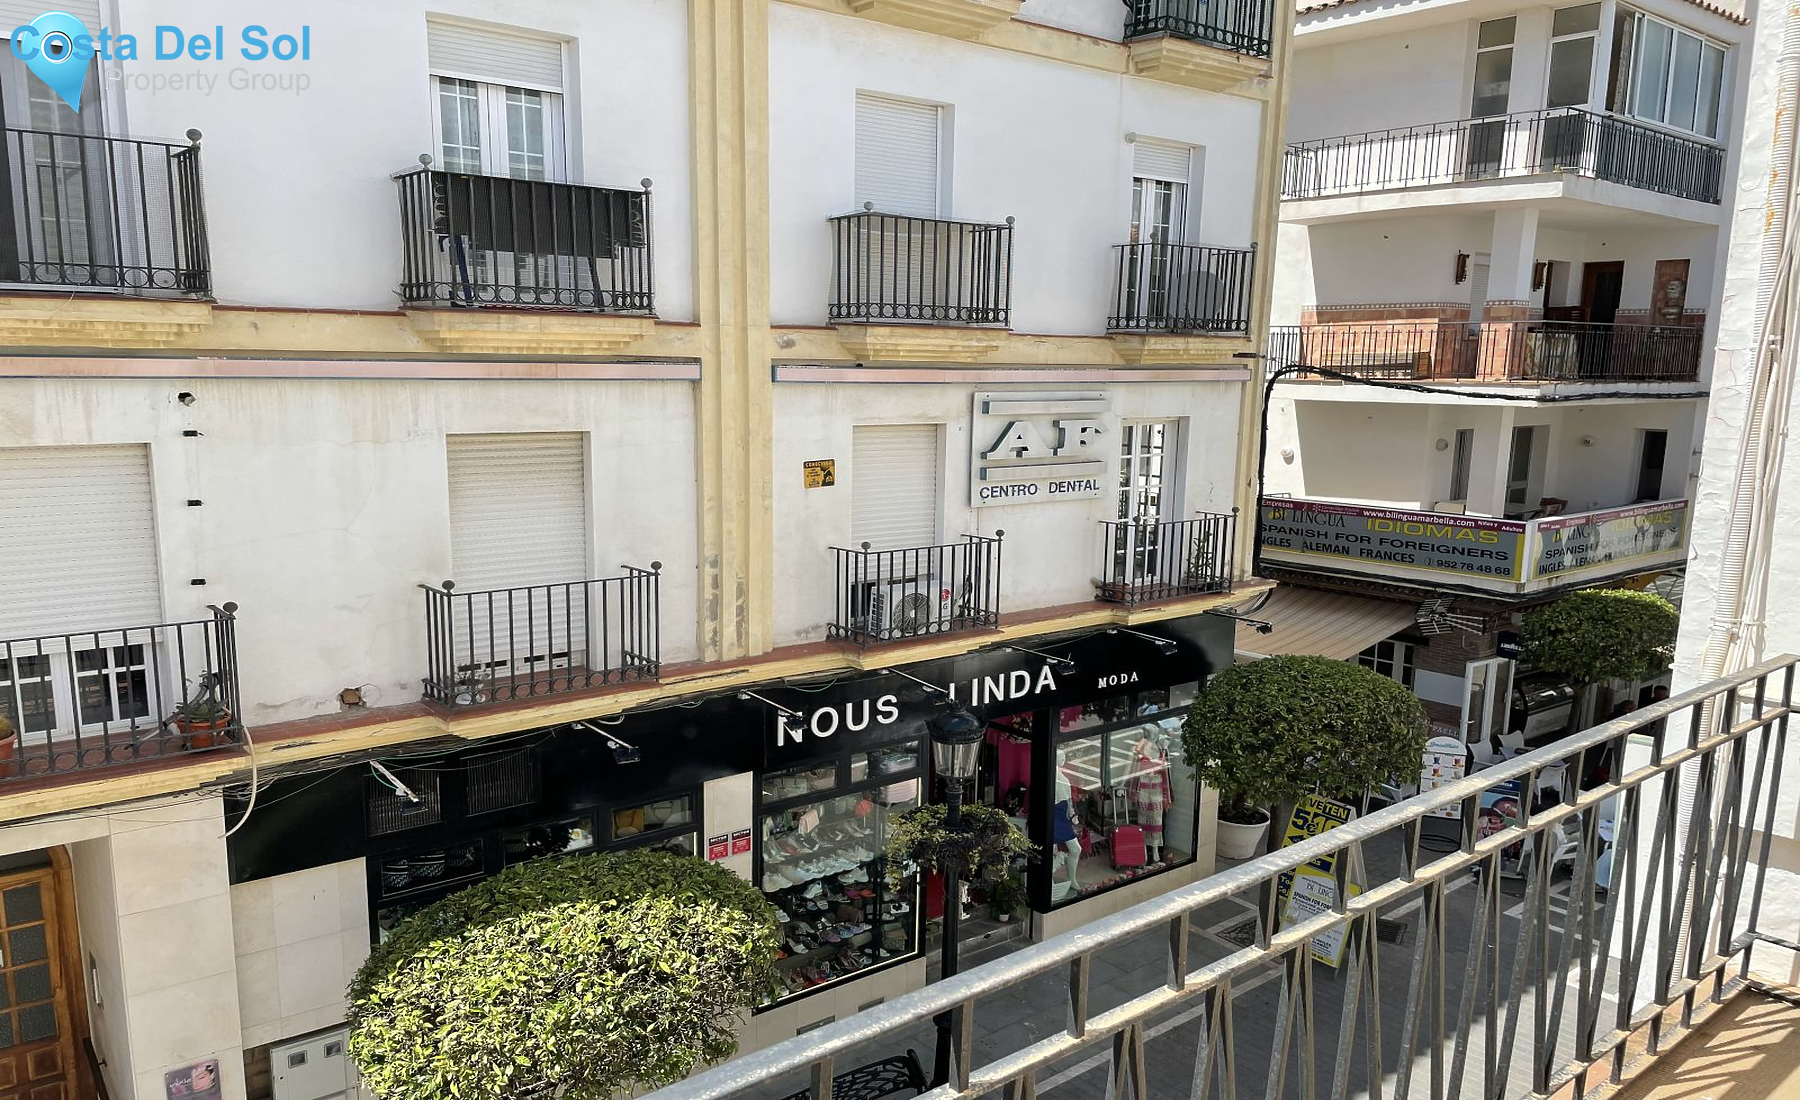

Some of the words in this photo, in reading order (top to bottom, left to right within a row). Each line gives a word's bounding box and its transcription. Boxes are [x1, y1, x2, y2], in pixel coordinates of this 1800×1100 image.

[979, 483, 1038, 499] CENTRO
[1049, 478, 1100, 493] DENTAL
[1292, 510, 1346, 528] LINGUA
[1363, 509, 1475, 527] www.bilinguamarbella.com
[1261, 523, 1328, 540] SPANISH
[1335, 532, 1372, 545] FOR
[1379, 537, 1509, 561] FOREIGNERS
[1367, 518, 1499, 544] IDIOMAS
[1261, 535, 1292, 548] NGLES
[1303, 539, 1350, 555] ALEMAN
[1359, 547, 1415, 564] FRANCES
[1436, 559, 1457, 569] 952
[1460, 562, 1474, 571] 78
[1476, 564, 1492, 573] 48
[1494, 566, 1511, 576] 68
[776, 694, 899, 747] NOUS
[1098, 671, 1139, 689] MODA
[1324, 803, 1347, 819] TEN
